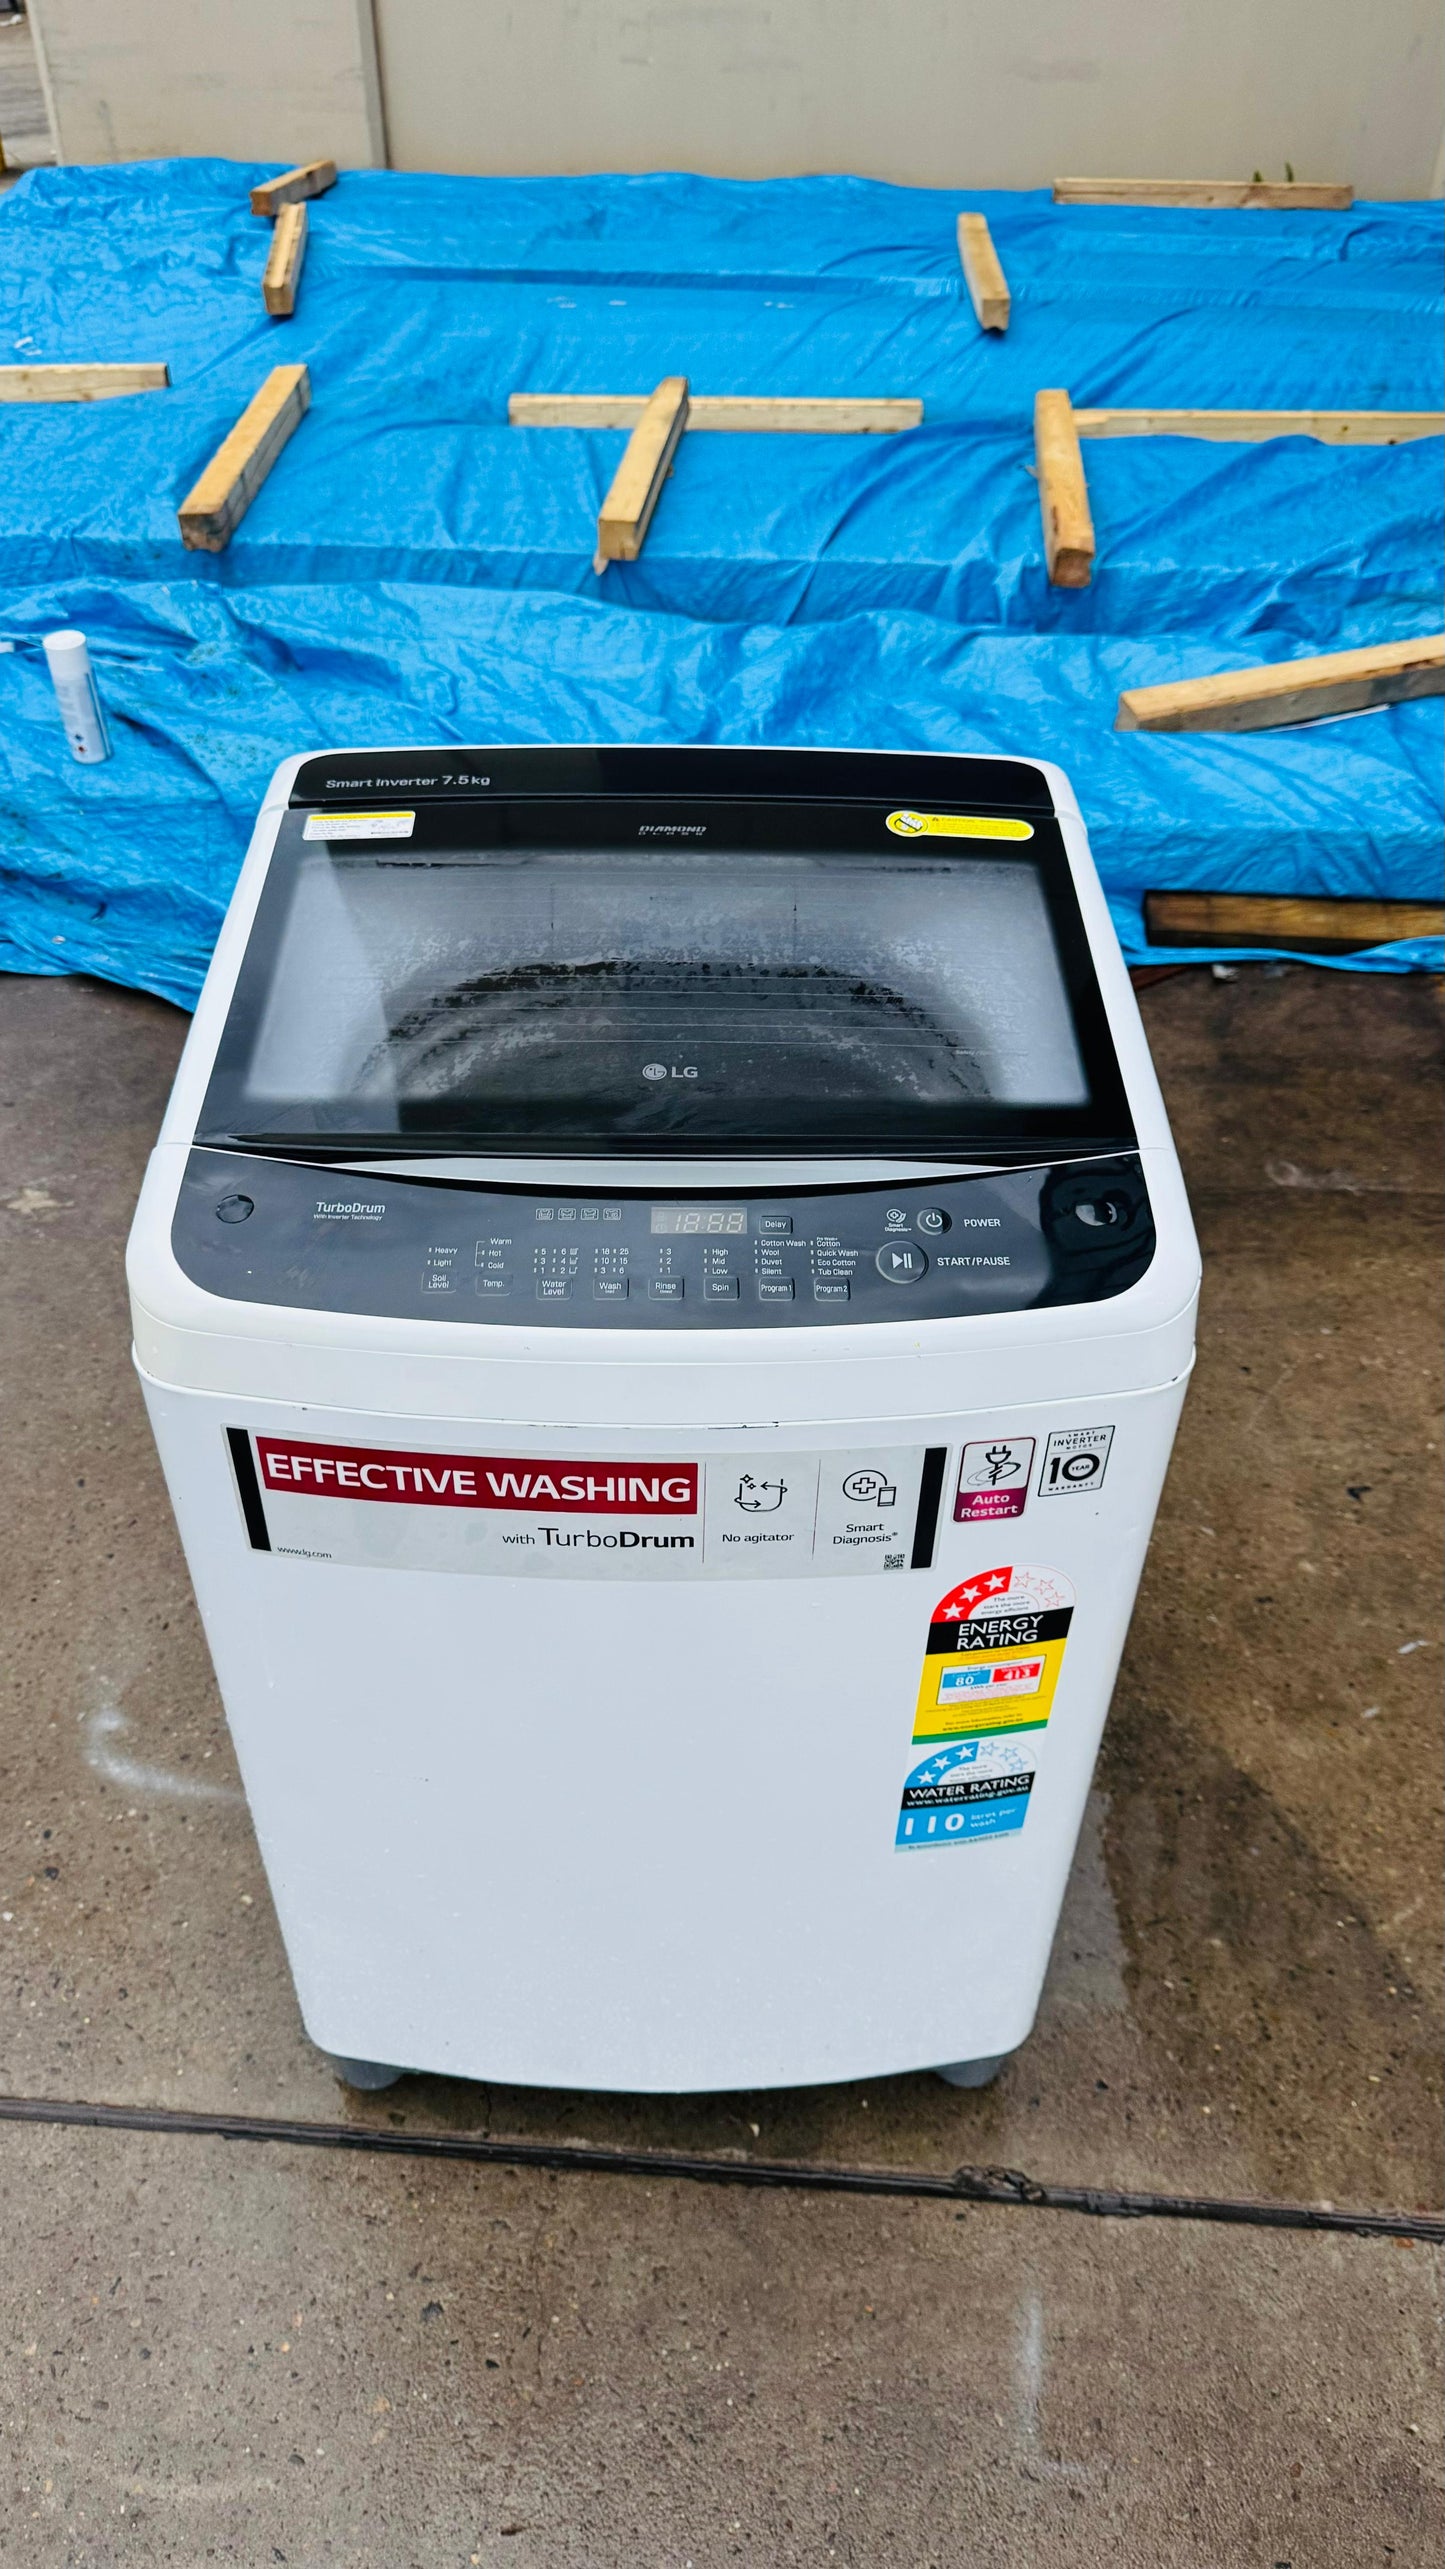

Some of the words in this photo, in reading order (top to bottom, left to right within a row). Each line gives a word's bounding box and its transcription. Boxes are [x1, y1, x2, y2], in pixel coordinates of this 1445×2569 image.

[326, 779, 372, 788] Smart
[376, 777, 438, 788] Inverter
[671, 1066, 698, 1078] LG
[316, 1201, 386, 1214] TurboDrum
[765, 1220, 786, 1230] Delay
[964, 1218, 1001, 1227] POWER
[433, 1259, 452, 1267] Light
[937, 1256, 1010, 1266] START/PAUSE
[483, 1280, 505, 1288] Temp.
[541, 1280, 566, 1288] Water
[599, 1282, 622, 1290] Wash
[655, 1282, 676, 1290] Rinse
[712, 1284, 729, 1292] Spin
[761, 1284, 788, 1293] Program
[543, 1288, 564, 1296] Level
[1054, 1434, 1106, 1446] INVERTER
[1049, 1453, 1100, 1484] 10
[265, 1453, 477, 1496] EFFECTIVE
[485, 1472, 692, 1502] WASHING
[972, 1494, 1010, 1505] Auto
[961, 1505, 1018, 1518] Restart
[846, 1523, 884, 1533] Smart
[502, 1533, 535, 1546] with
[537, 1527, 695, 1548] TurboDrum
[722, 1533, 741, 1543] No
[745, 1533, 794, 1544] agitator
[277, 1547, 332, 1559] www.lg.com
[958, 1615, 1044, 1636] ENERGY
[956, 1630, 1038, 1650] RATING
[955, 1676, 974, 1686] 80
[909, 1786, 966, 1799] WATER
[970, 1775, 1030, 1795] RATING
[906, 1785, 1029, 1807] www.waterrating.gov.au
[999, 1808, 1017, 1817] per
[904, 1813, 965, 1836] 110
[970, 1819, 997, 1828] wash
